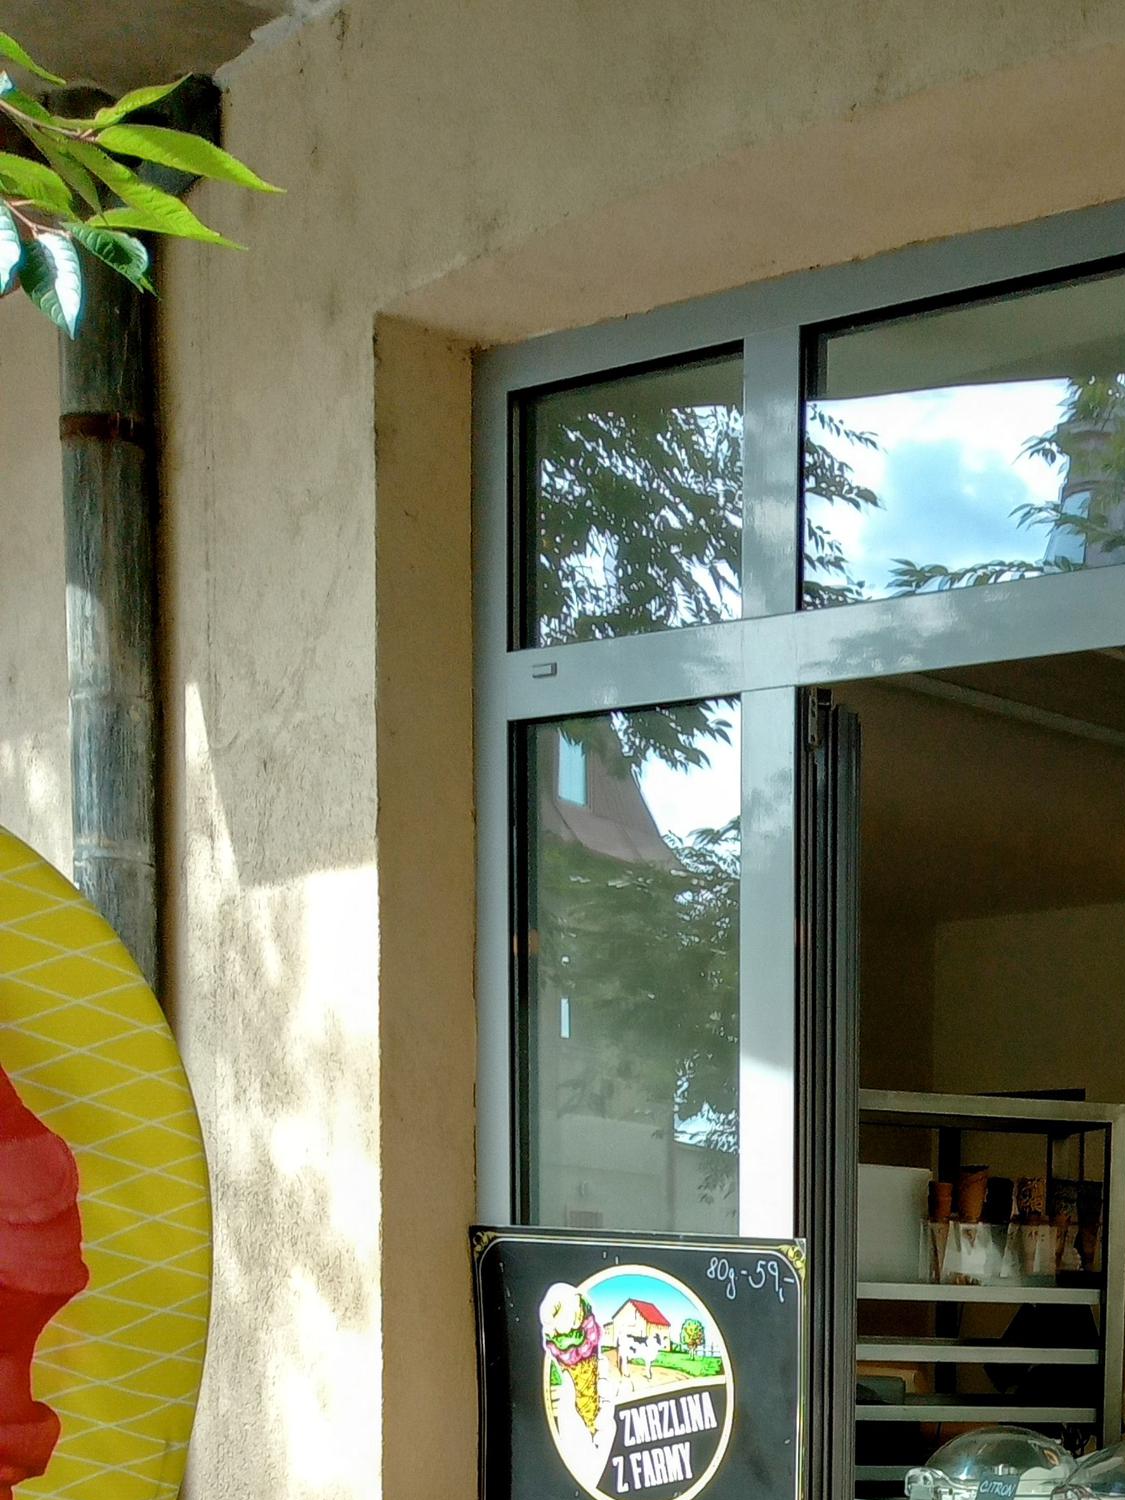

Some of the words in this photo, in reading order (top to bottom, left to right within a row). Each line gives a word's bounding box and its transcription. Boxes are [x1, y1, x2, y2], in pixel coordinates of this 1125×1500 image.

[618, 1391, 718, 1447] ZMRZLINA
[612, 1455, 629, 1493] Z
[629, 1441, 693, 1490] FARMY
[979, 1480, 1017, 1497] CITRON
